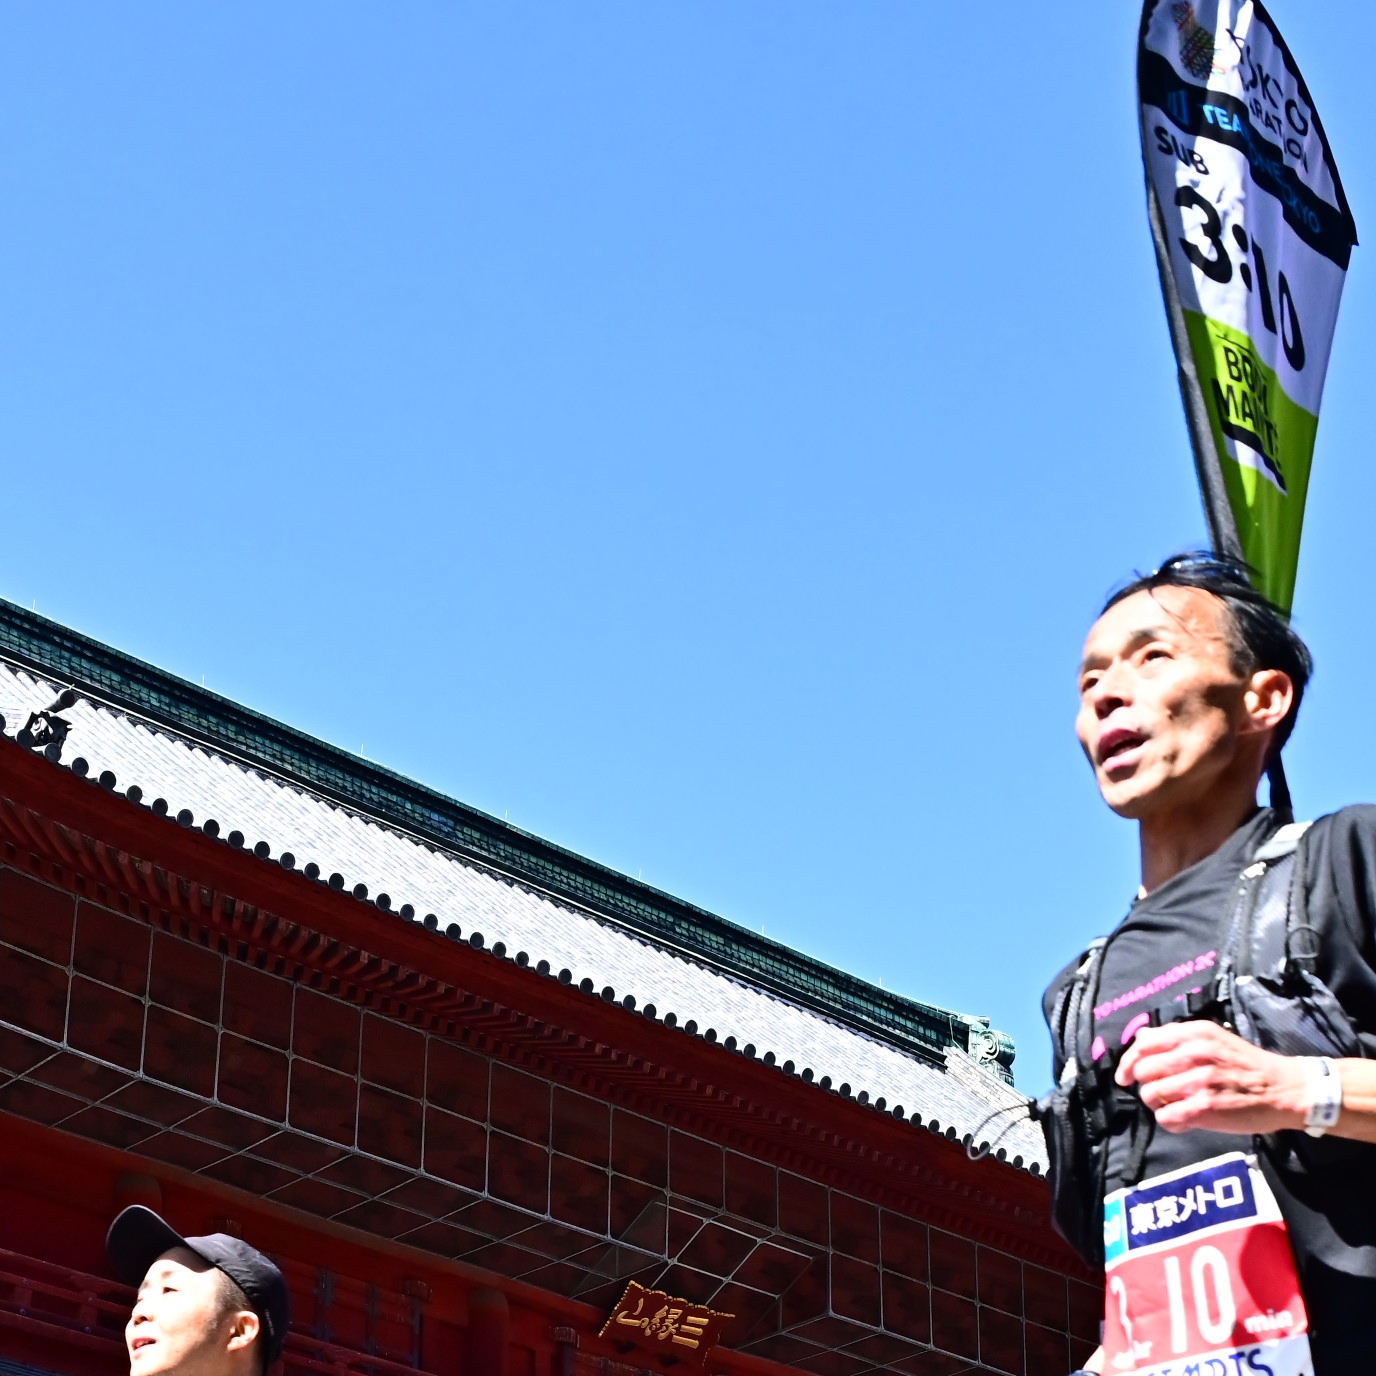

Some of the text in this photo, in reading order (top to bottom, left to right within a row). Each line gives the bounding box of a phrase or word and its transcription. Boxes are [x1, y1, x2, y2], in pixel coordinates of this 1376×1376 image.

[1154, 125, 1210, 176] SUB
[1176, 185, 1305, 372] 3:10
[1130, 1177, 1243, 1234] 東京メトロ
[1164, 1245, 1236, 1355] 10
[1244, 1308, 1294, 1333] min
